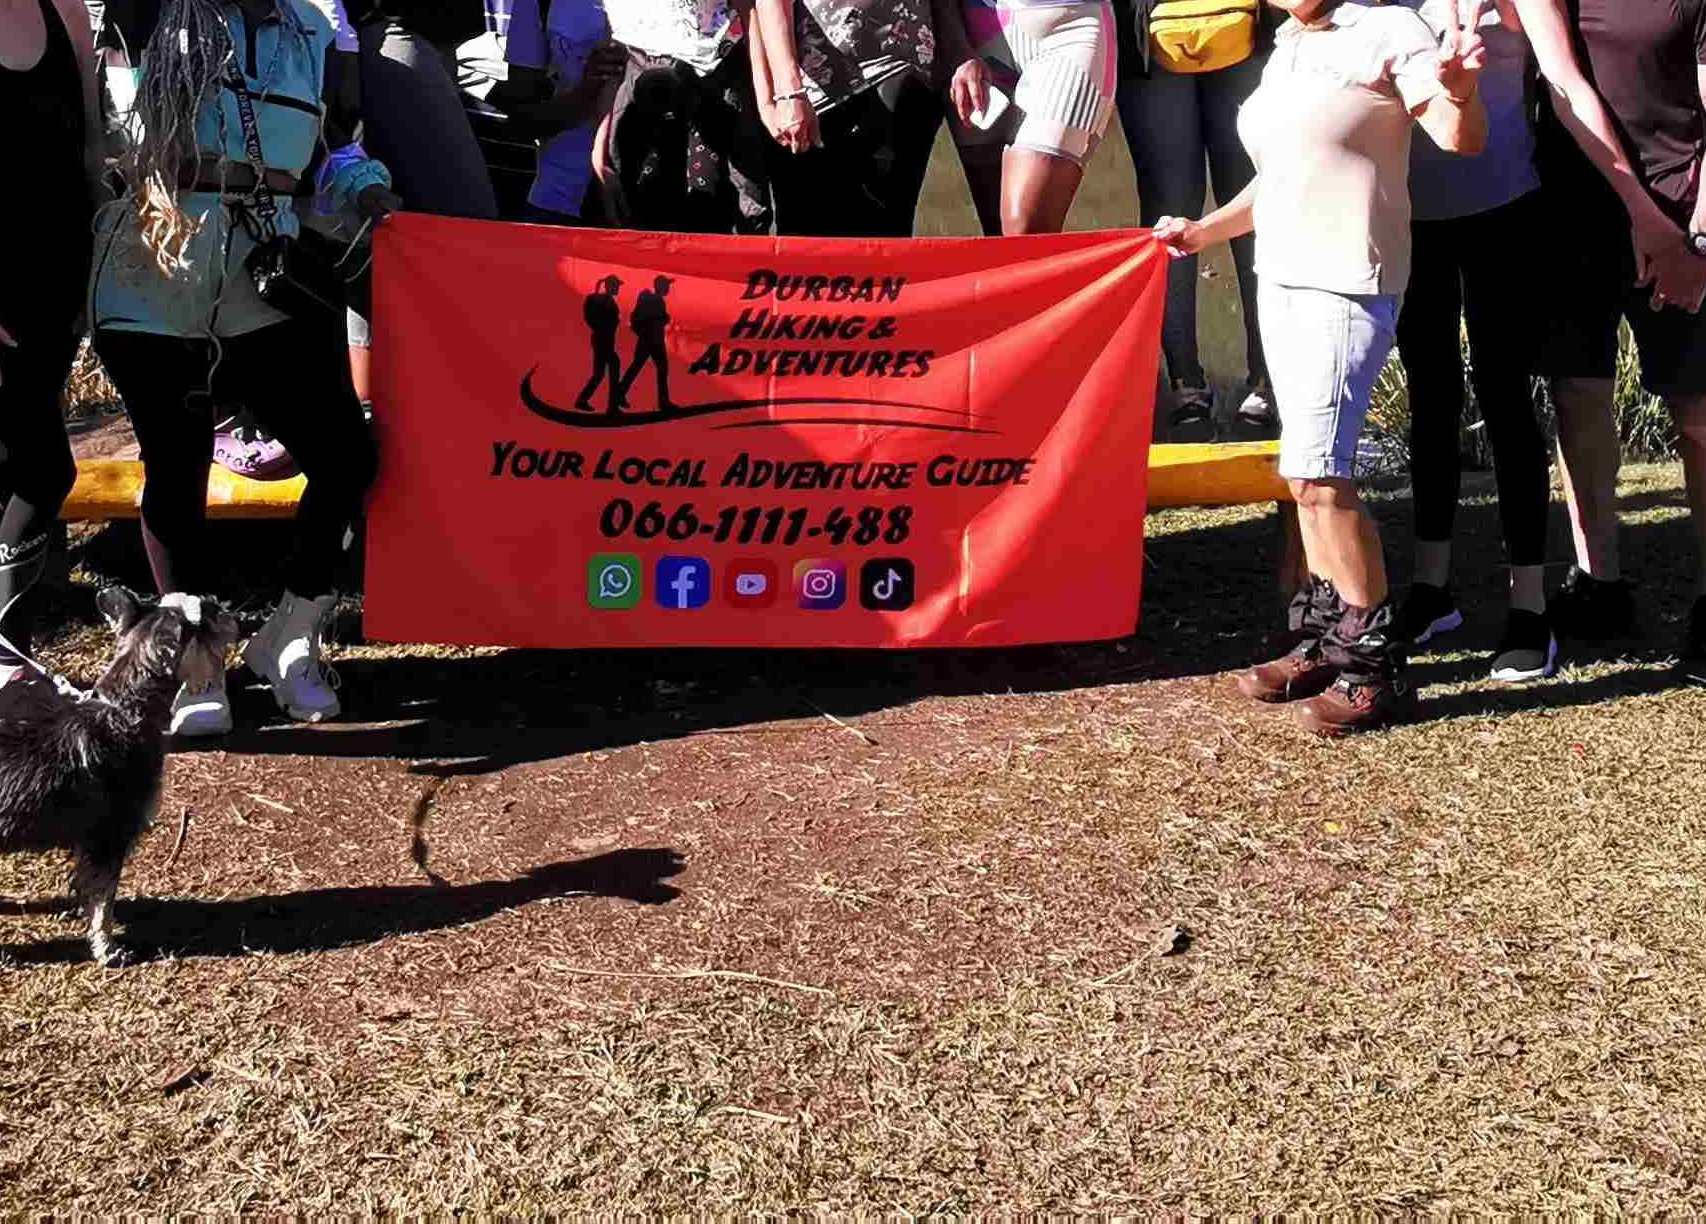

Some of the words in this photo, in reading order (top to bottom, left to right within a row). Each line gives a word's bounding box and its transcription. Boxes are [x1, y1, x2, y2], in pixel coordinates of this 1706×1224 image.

[740, 269, 906, 303] DURBAN
[729, 307, 866, 340] HIKING
[869, 316, 898, 340] &
[688, 343, 934, 378] ADVENTURES
[491, 441, 584, 478] YOUR
[593, 449, 708, 488] LOCAL
[720, 452, 917, 490] ADVENTURE
[926, 455, 1035, 487] GUIDE
[600, 498, 912, 545] 066-1111-488
